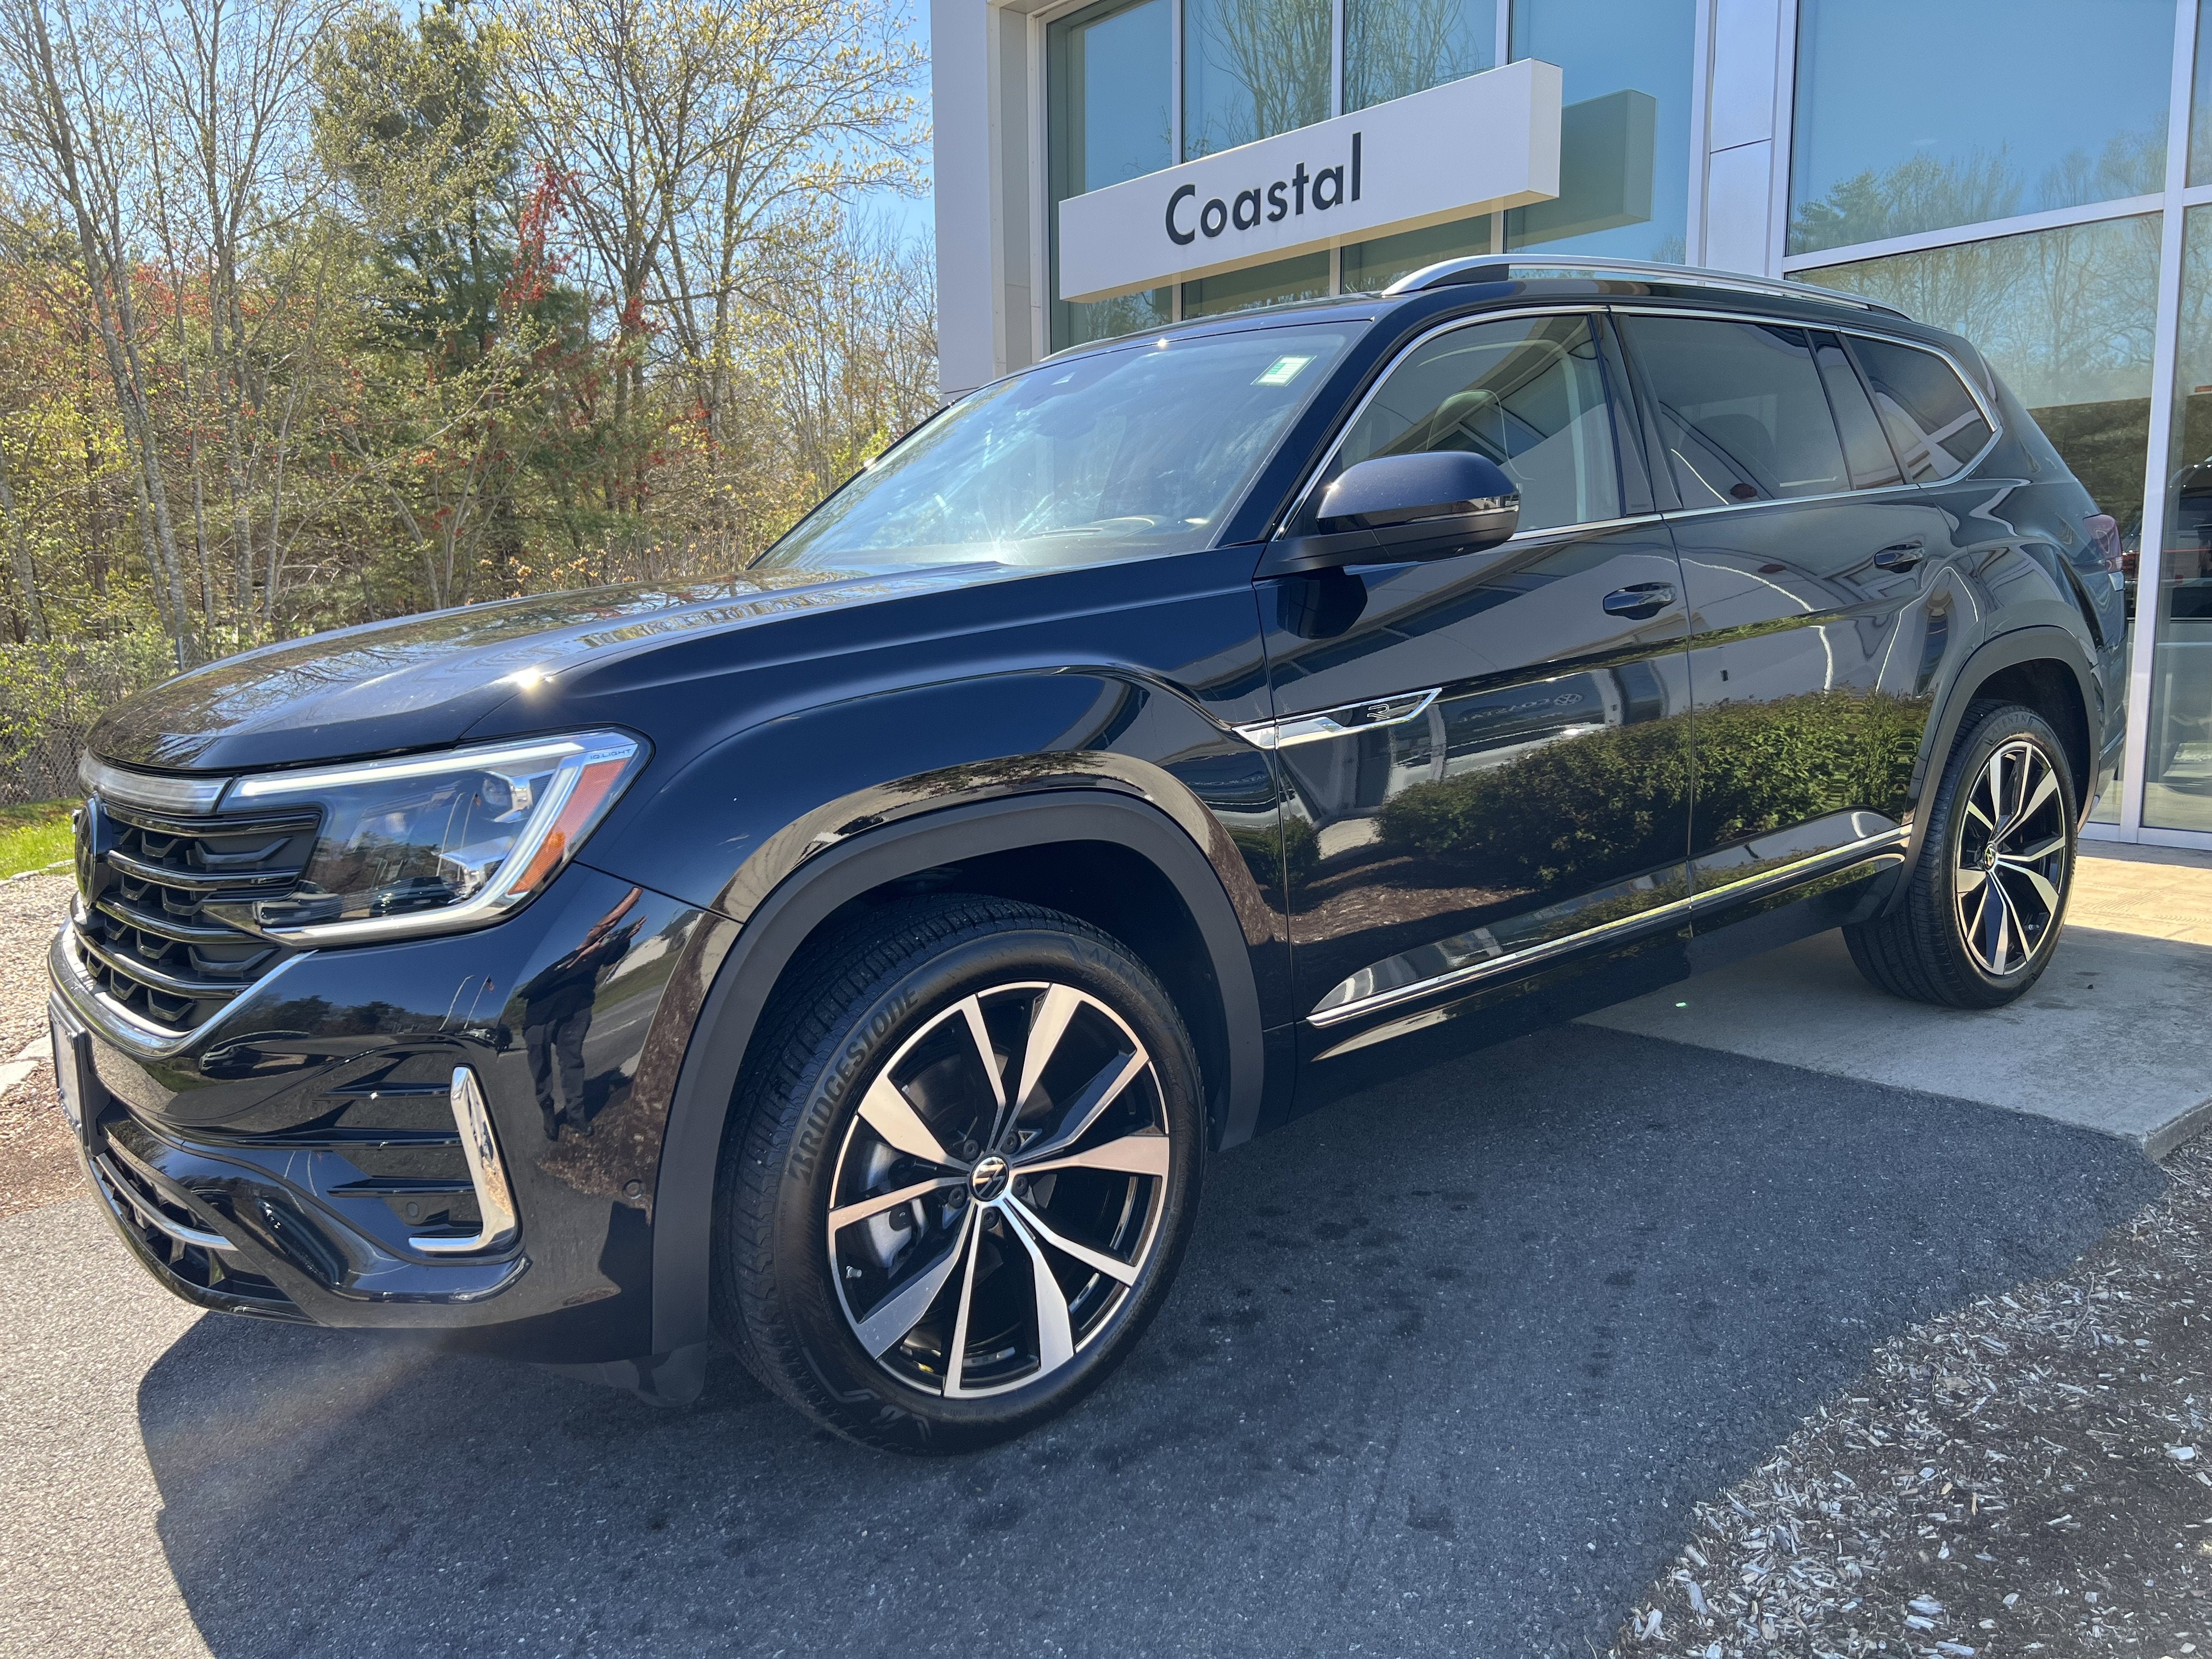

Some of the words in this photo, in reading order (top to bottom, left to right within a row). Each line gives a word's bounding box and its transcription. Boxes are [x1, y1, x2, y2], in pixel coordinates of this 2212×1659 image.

[1165, 132, 1362, 245] Coastal
[1367, 703, 1390, 719] R
[591, 749, 631, 759] IQ.LIGHT
[788, 987, 919, 1185] BRIDGESTONE
